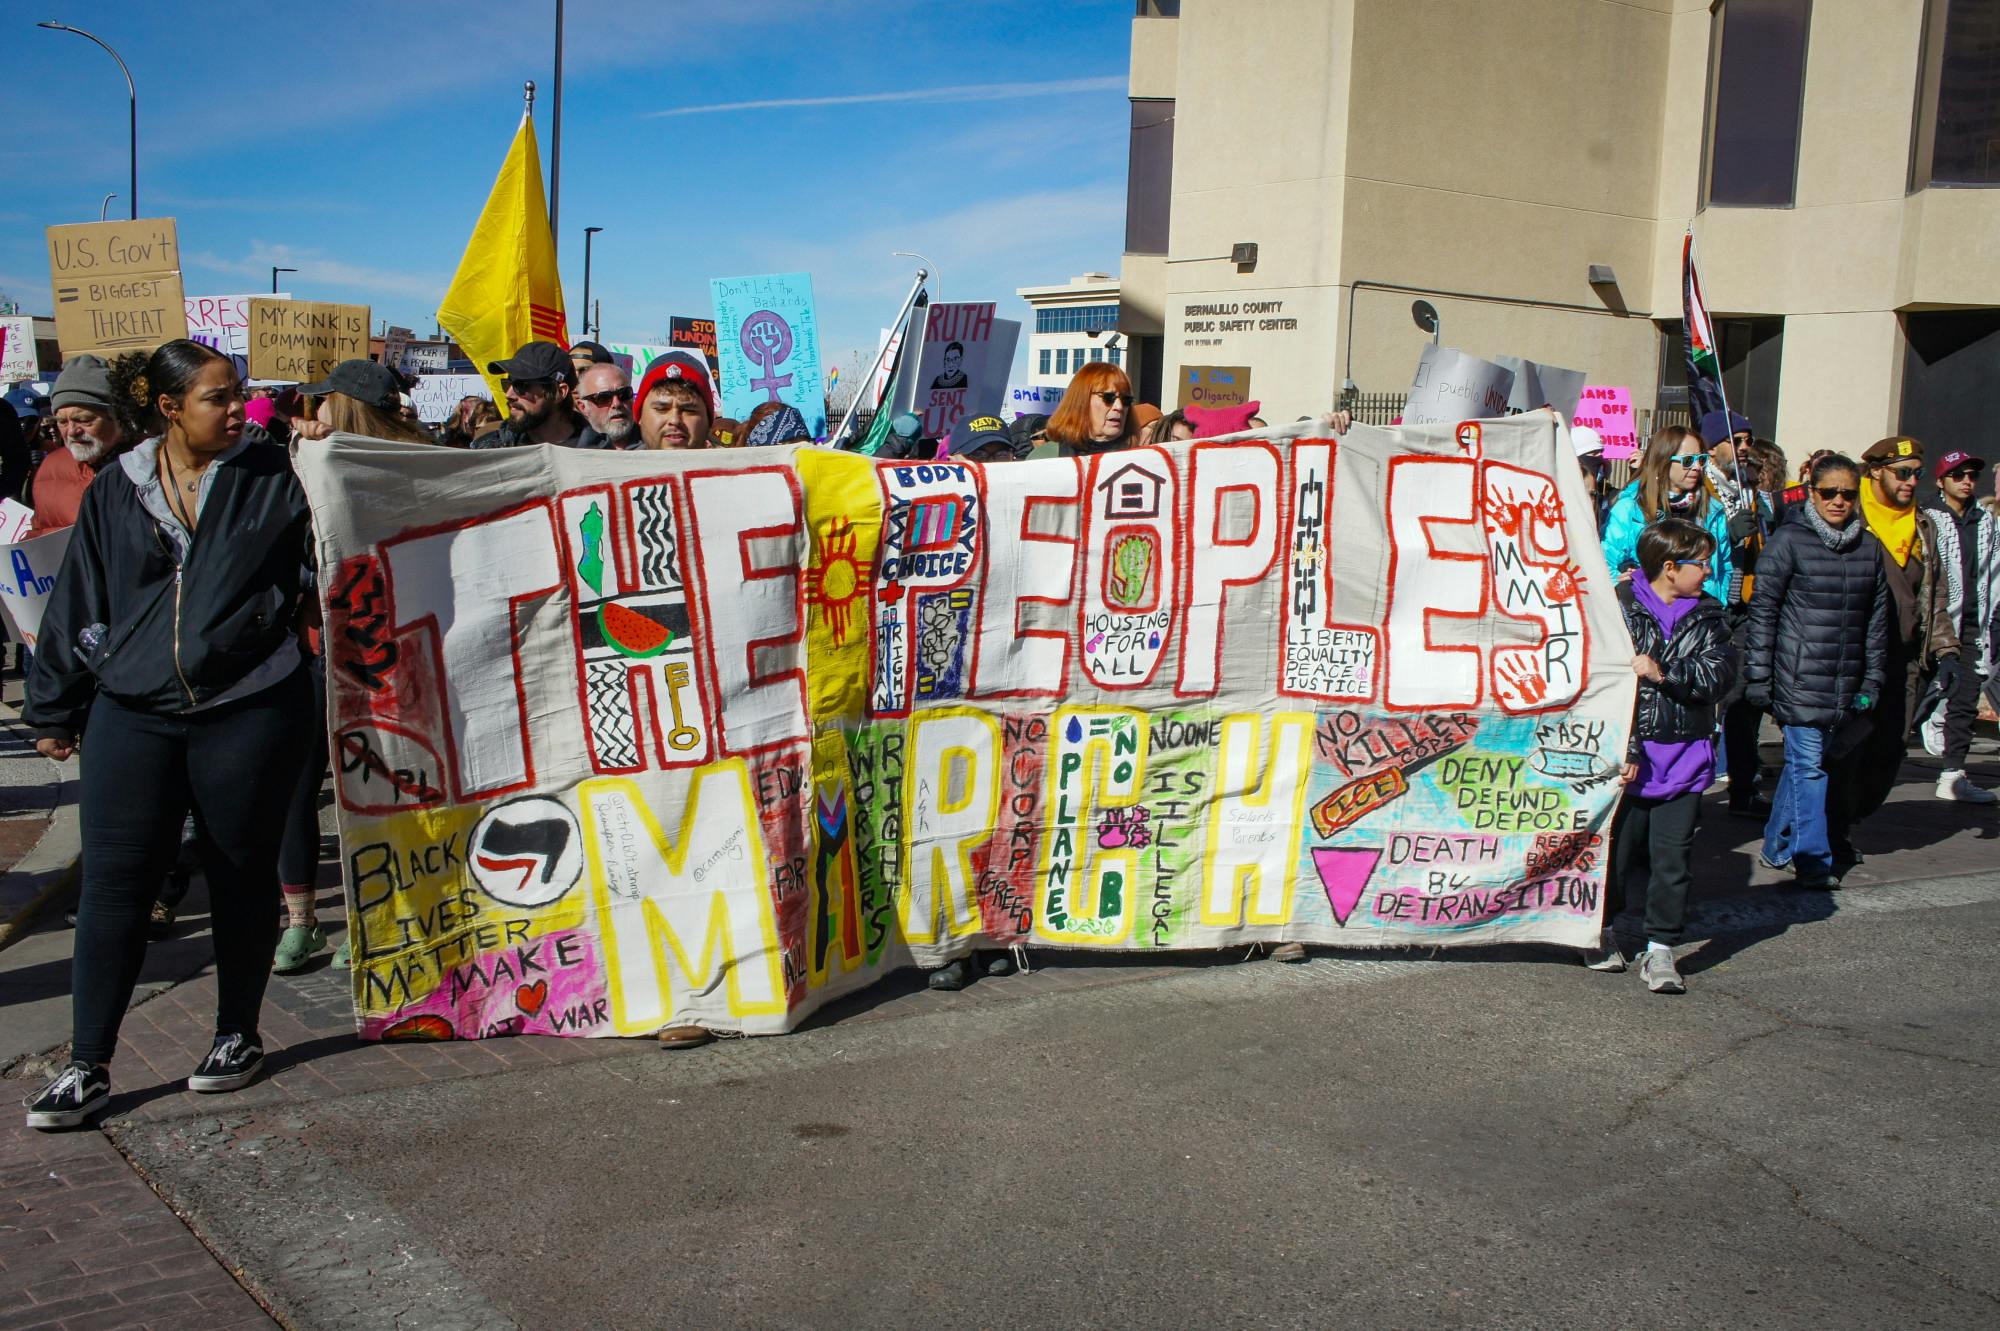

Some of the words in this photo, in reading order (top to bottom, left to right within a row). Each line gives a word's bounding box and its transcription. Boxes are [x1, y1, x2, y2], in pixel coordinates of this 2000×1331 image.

[54, 238, 99, 270] U.S.
[108, 233, 171, 265] Gov't
[89, 281, 160, 301] BIGGEST
[84, 309, 166, 338] THREAT
[261, 307, 287, 326] MY
[294, 312, 339, 330] KINK
[348, 317, 361, 332] IS
[925, 304, 996, 342] RUTH
[1185, 303, 1238, 316] BERNALILLO
[1243, 302, 1282, 313] COUNTY
[1184, 321, 1215, 333] PUBLIC
[1219, 319, 1256, 332] SAFETY
[1259, 318, 1297, 331] CENTER
[259, 332, 360, 352] COMMUNITY
[276, 356, 316, 375] CARE
[440, 378, 469, 392] NOT
[929, 389, 967, 407] SENT
[1013, 386, 1041, 402] and
[1192, 387, 1244, 404] Oligarchy
[969, 416, 1002, 431] NAVY
[1573, 416, 1603, 428] OUR
[1601, 404, 1628, 415] OFF
[895, 464, 966, 488] BODY
[886, 493, 911, 549] MY
[882, 552, 969, 580] CHOICE
[376, 464, 811, 803] THE
[1085, 614, 1170, 633] HOUSING
[1105, 631, 1146, 653] FOR
[1287, 628, 1373, 649] LIBERTY
[875, 627, 888, 708] HUMAN
[892, 627, 904, 710] RIGHT
[1092, 655, 1144, 676] ALL
[1286, 647, 1373, 668] EQUALITY
[1286, 661, 1354, 678] PEACE
[1286, 676, 1368, 694] JUSTICE
[1004, 718, 1047, 747] NO
[1316, 710, 1361, 756] NO
[1335, 712, 1480, 776] KILLER
[1535, 720, 1605, 752] MASK
[1113, 725, 1137, 784] NO
[1400, 733, 1455, 765] COPS
[1152, 770, 1206, 795] IS
[1442, 757, 1526, 793] DENY
[1009, 747, 1036, 871] CORP
[1328, 776, 1396, 814] ICE
[1457, 787, 1561, 811] DEFUND
[1475, 809, 1589, 830] DEPOSE
[1046, 752, 1082, 931] PLANET
[1391, 835, 1498, 864] DEATH
[351, 832, 460, 913] BLACK
[774, 857, 805, 901] FOR
[1151, 801, 1190, 947] ILLEGAL
[979, 870, 1033, 935] GREED
[1100, 871, 1123, 919] B
[1377, 876, 1599, 921] DETRANSITION
[361, 888, 480, 960] LIVES
[366, 918, 532, 1009] MATTER
[451, 934, 584, 1005] MAKE
[548, 998, 609, 1033] WAR
